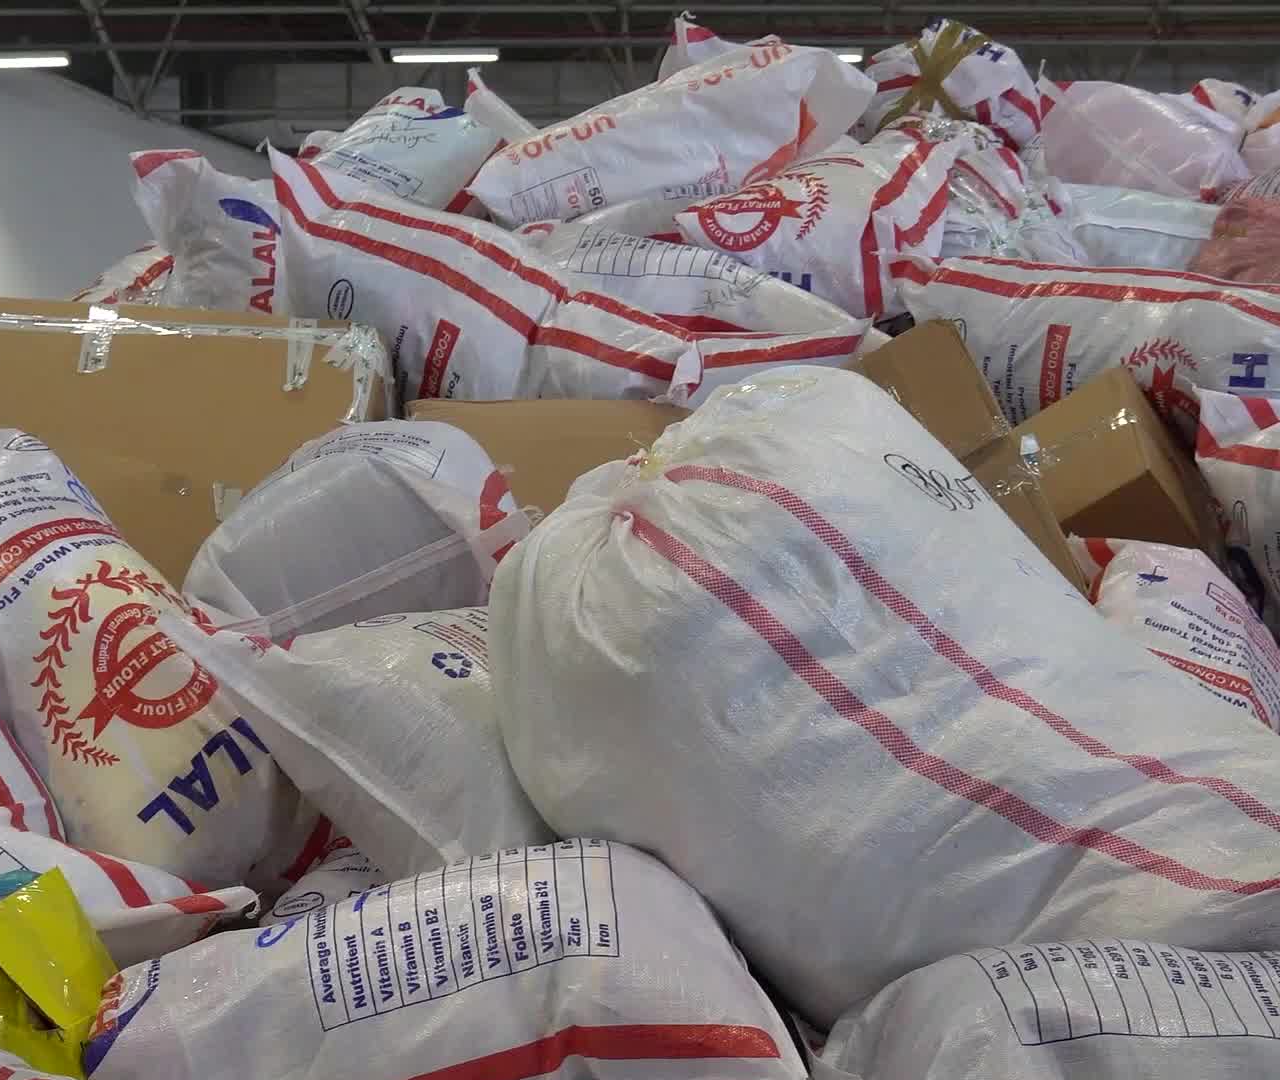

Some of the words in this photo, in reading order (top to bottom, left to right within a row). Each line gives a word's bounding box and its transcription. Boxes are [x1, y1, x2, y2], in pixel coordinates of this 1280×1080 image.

[250, 230, 277, 314] ALAL
[22, 547, 72, 586] Wheat
[103, 650, 150, 700] FLOUR
[132, 697, 189, 718] Flour
[459, 923, 474, 979] Niancin
[485, 914, 502, 969] Vitamin
[514, 913, 529, 961] Folate
[539, 902, 554, 953] Vitamin
[568, 917, 583, 947] Zinc
[597, 923, 610, 948] Iron
[345, 934, 368, 1010] Nutritient
[373, 939, 394, 1003] Vitamin
[401, 934, 421, 995] Vitamin
[428, 927, 449, 988] Vitamin
[1116, 963, 1130, 979] mg
[1240, 960, 1268, 997] Content
